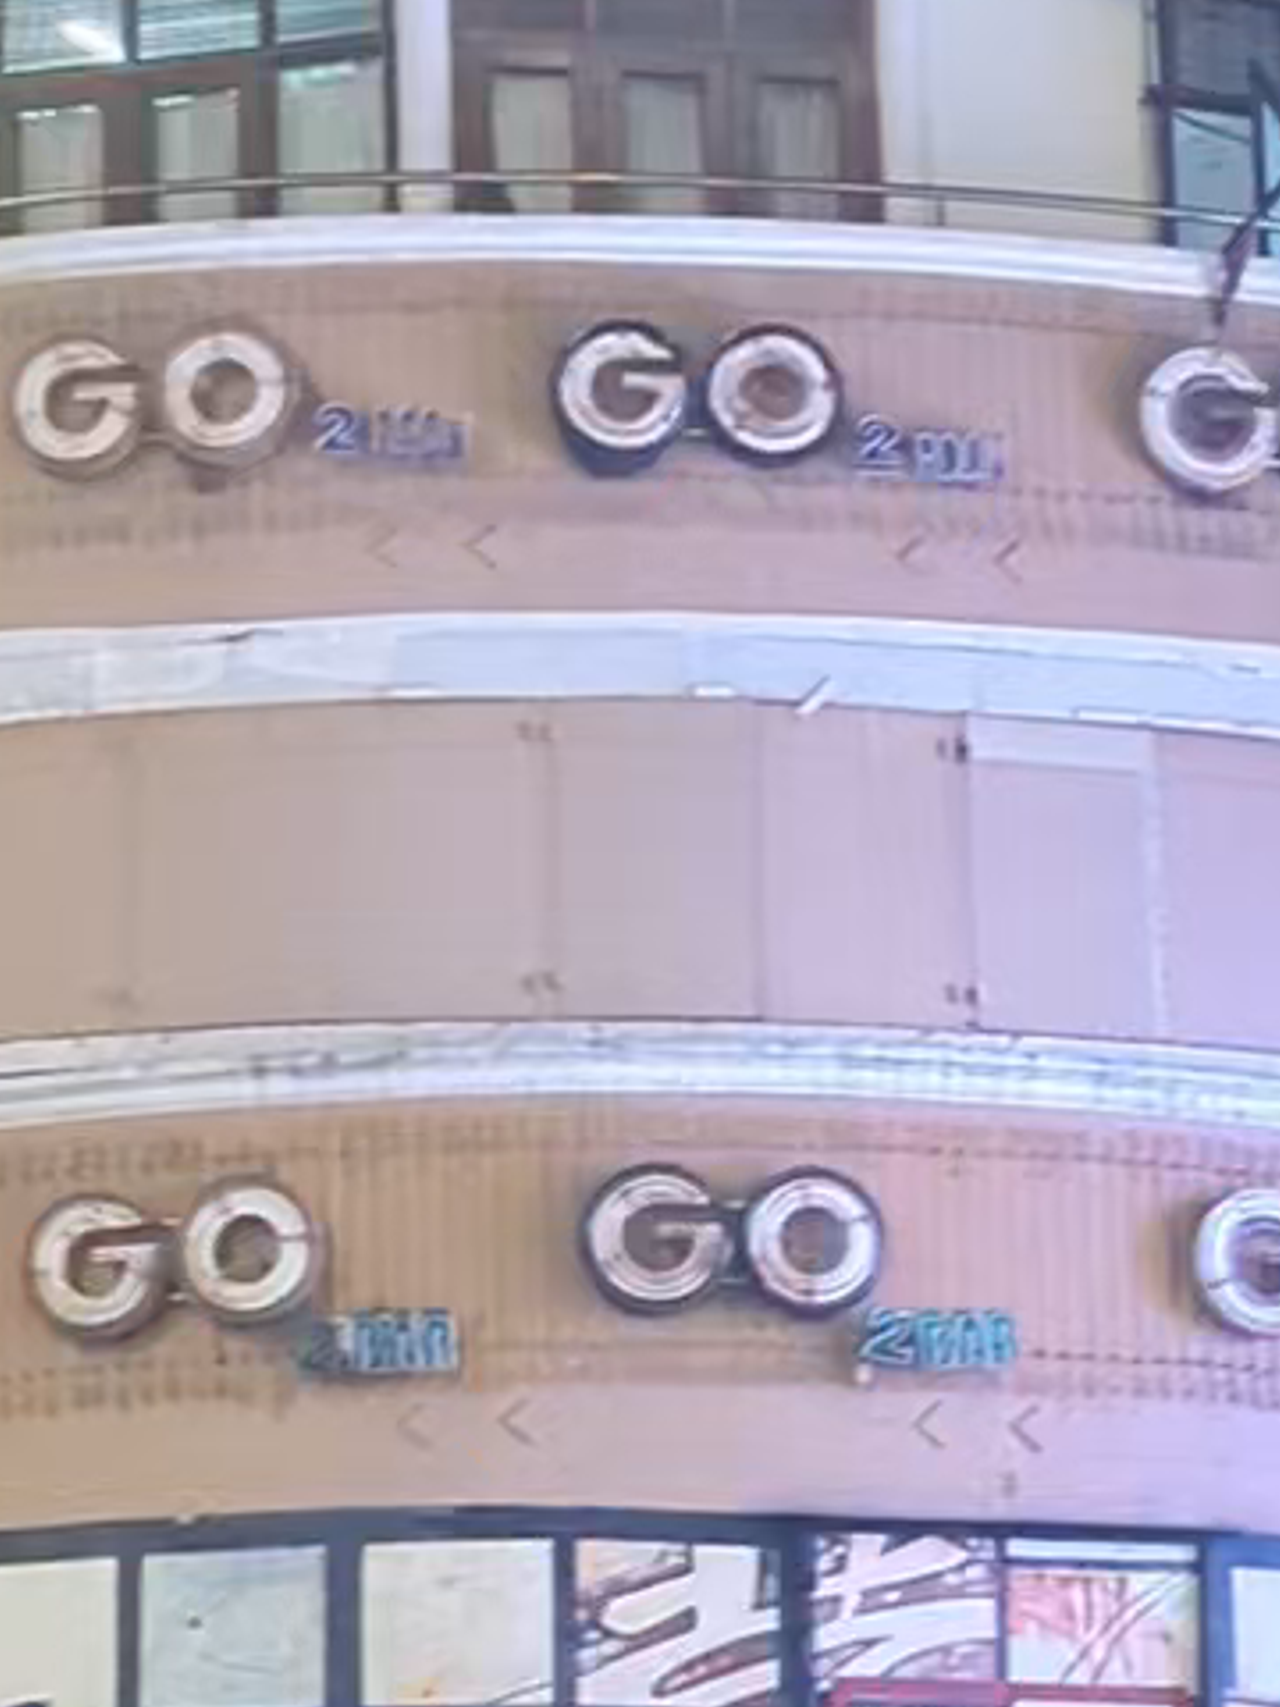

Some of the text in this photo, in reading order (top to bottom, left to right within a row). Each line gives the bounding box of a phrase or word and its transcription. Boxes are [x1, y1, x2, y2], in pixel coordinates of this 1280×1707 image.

[12, 327, 292, 465] GO
[554, 323, 842, 459] GO
[28, 1179, 314, 1331] GO
[582, 1165, 882, 1317] GO
